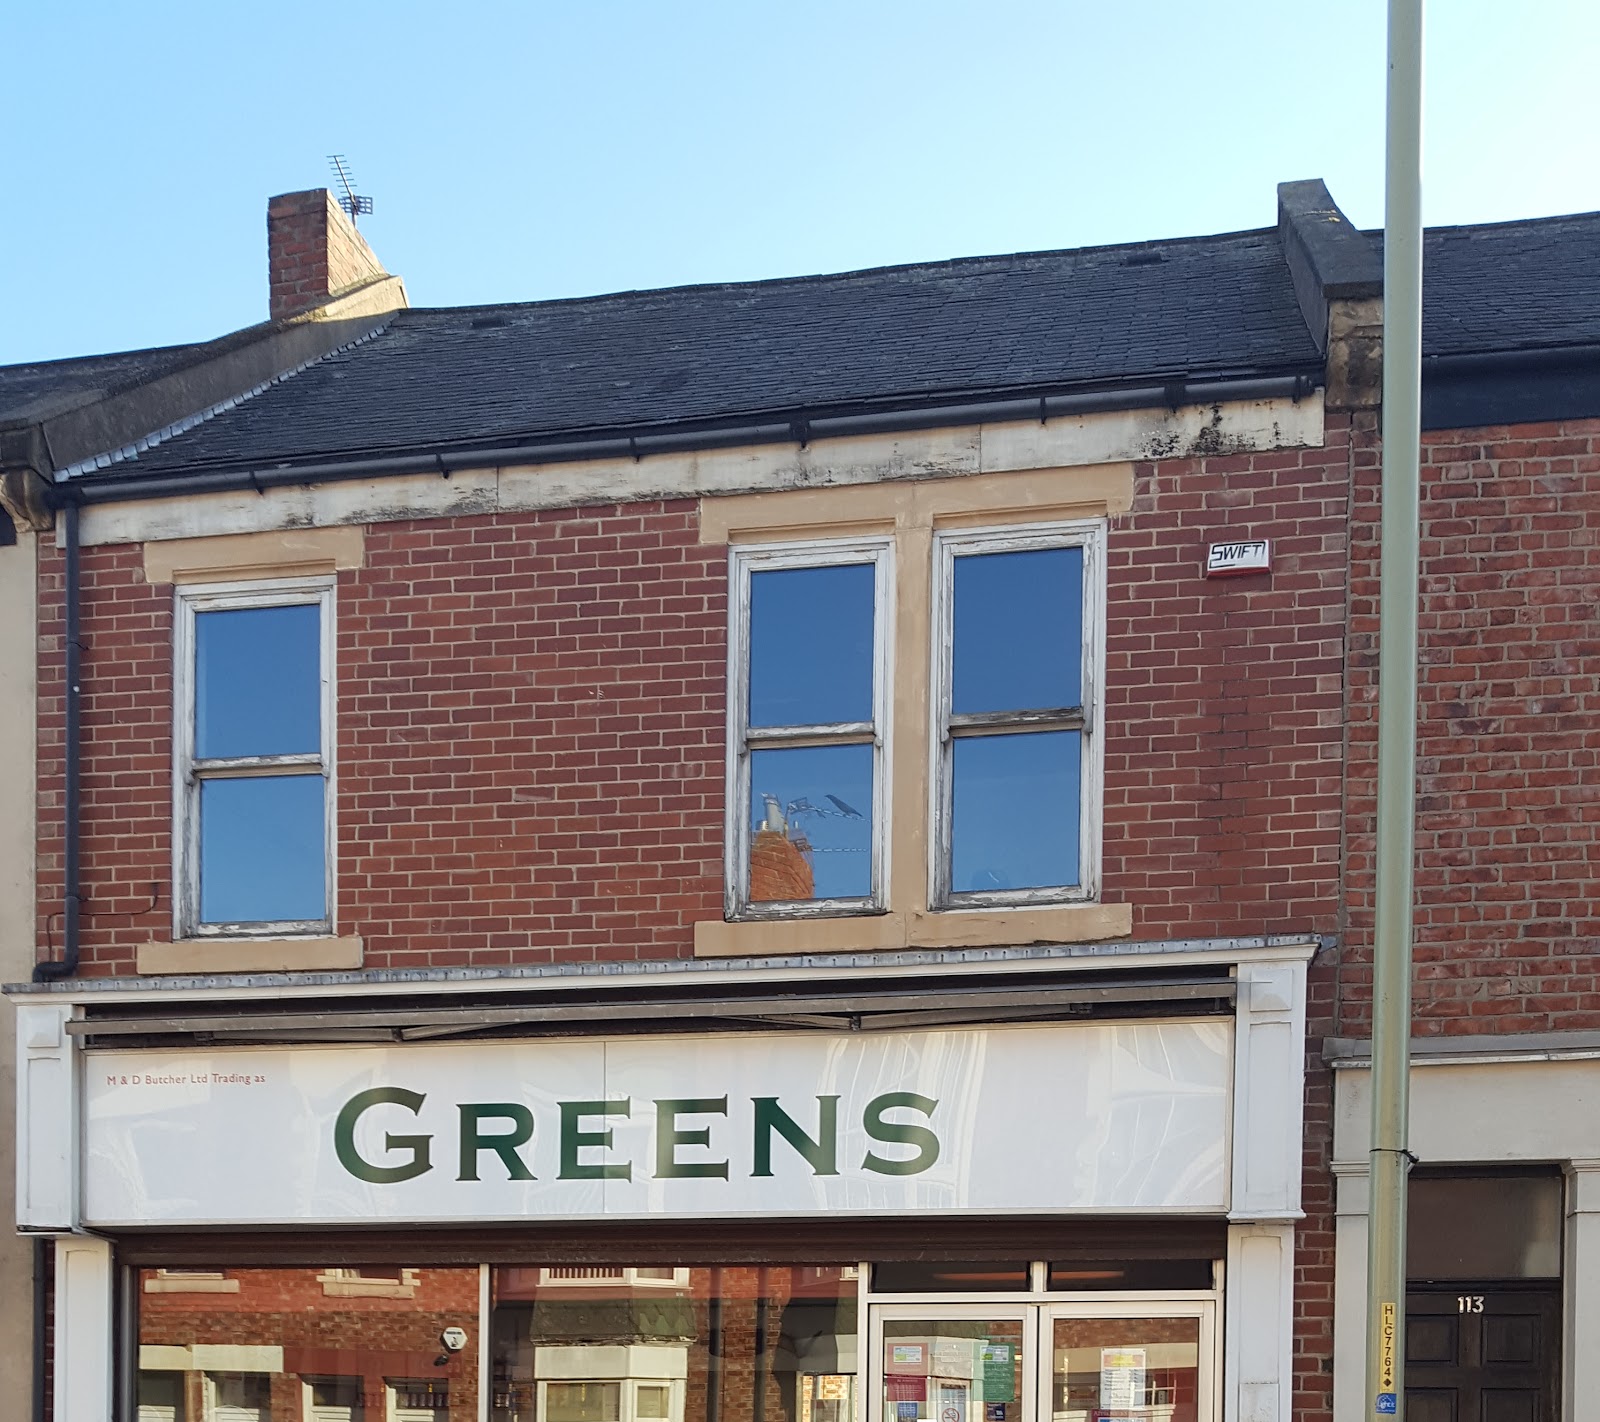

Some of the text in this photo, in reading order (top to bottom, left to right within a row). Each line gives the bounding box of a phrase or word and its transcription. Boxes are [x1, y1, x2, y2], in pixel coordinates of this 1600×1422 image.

[1209, 541, 1265, 565] SWIFT
[106, 1073, 266, 1085] M & D Butcher Ltd Trading as
[1457, 1296, 1485, 1314] 113
[1384, 1305, 1393, 1377] HLC7764
